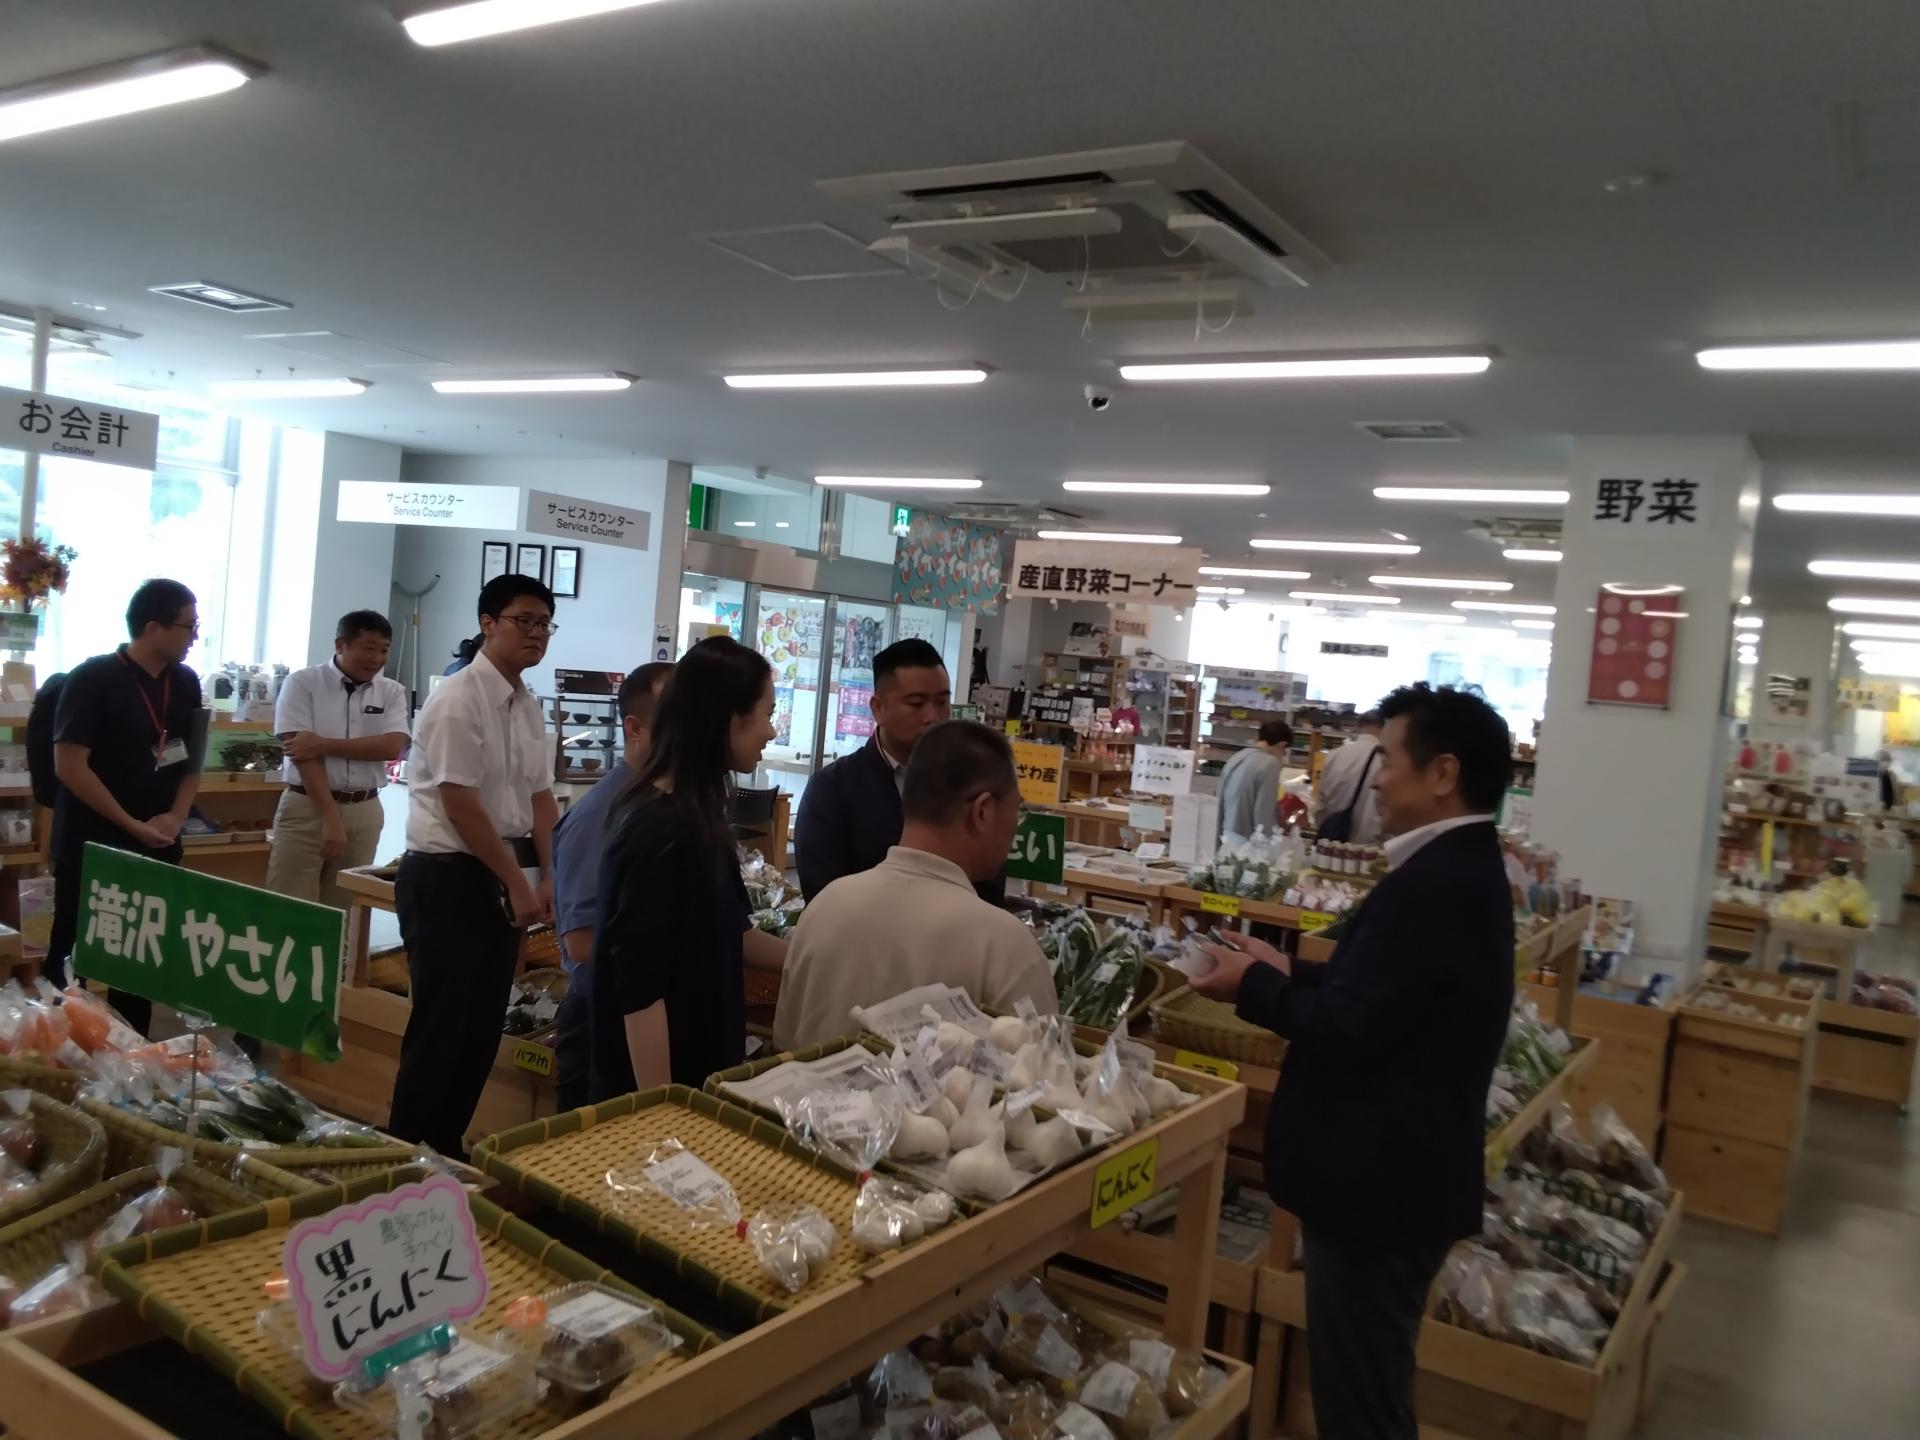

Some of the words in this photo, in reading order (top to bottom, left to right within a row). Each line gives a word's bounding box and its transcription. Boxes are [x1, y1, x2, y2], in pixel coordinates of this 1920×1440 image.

[19, 399, 130, 448] お会計
[52, 442, 96, 457] Cashier
[386, 491, 465, 507] サービスカウンター
[393, 506, 421, 518] Service
[422, 507, 454, 519] Counter
[547, 502, 635, 528] サービスカウンター
[1594, 478, 1699, 525] 野菜
[556, 518, 589, 534] Service
[591, 524, 624, 539] Counter
[1018, 564, 1194, 598] 産直野菜コーナー
[85, 878, 167, 969] 滝沢
[181, 908, 325, 1004] やさい
[1096, 1153, 1153, 1211] にんにく
[314, 1238, 373, 1309] 黒
[331, 1249, 469, 1351] にんにく
